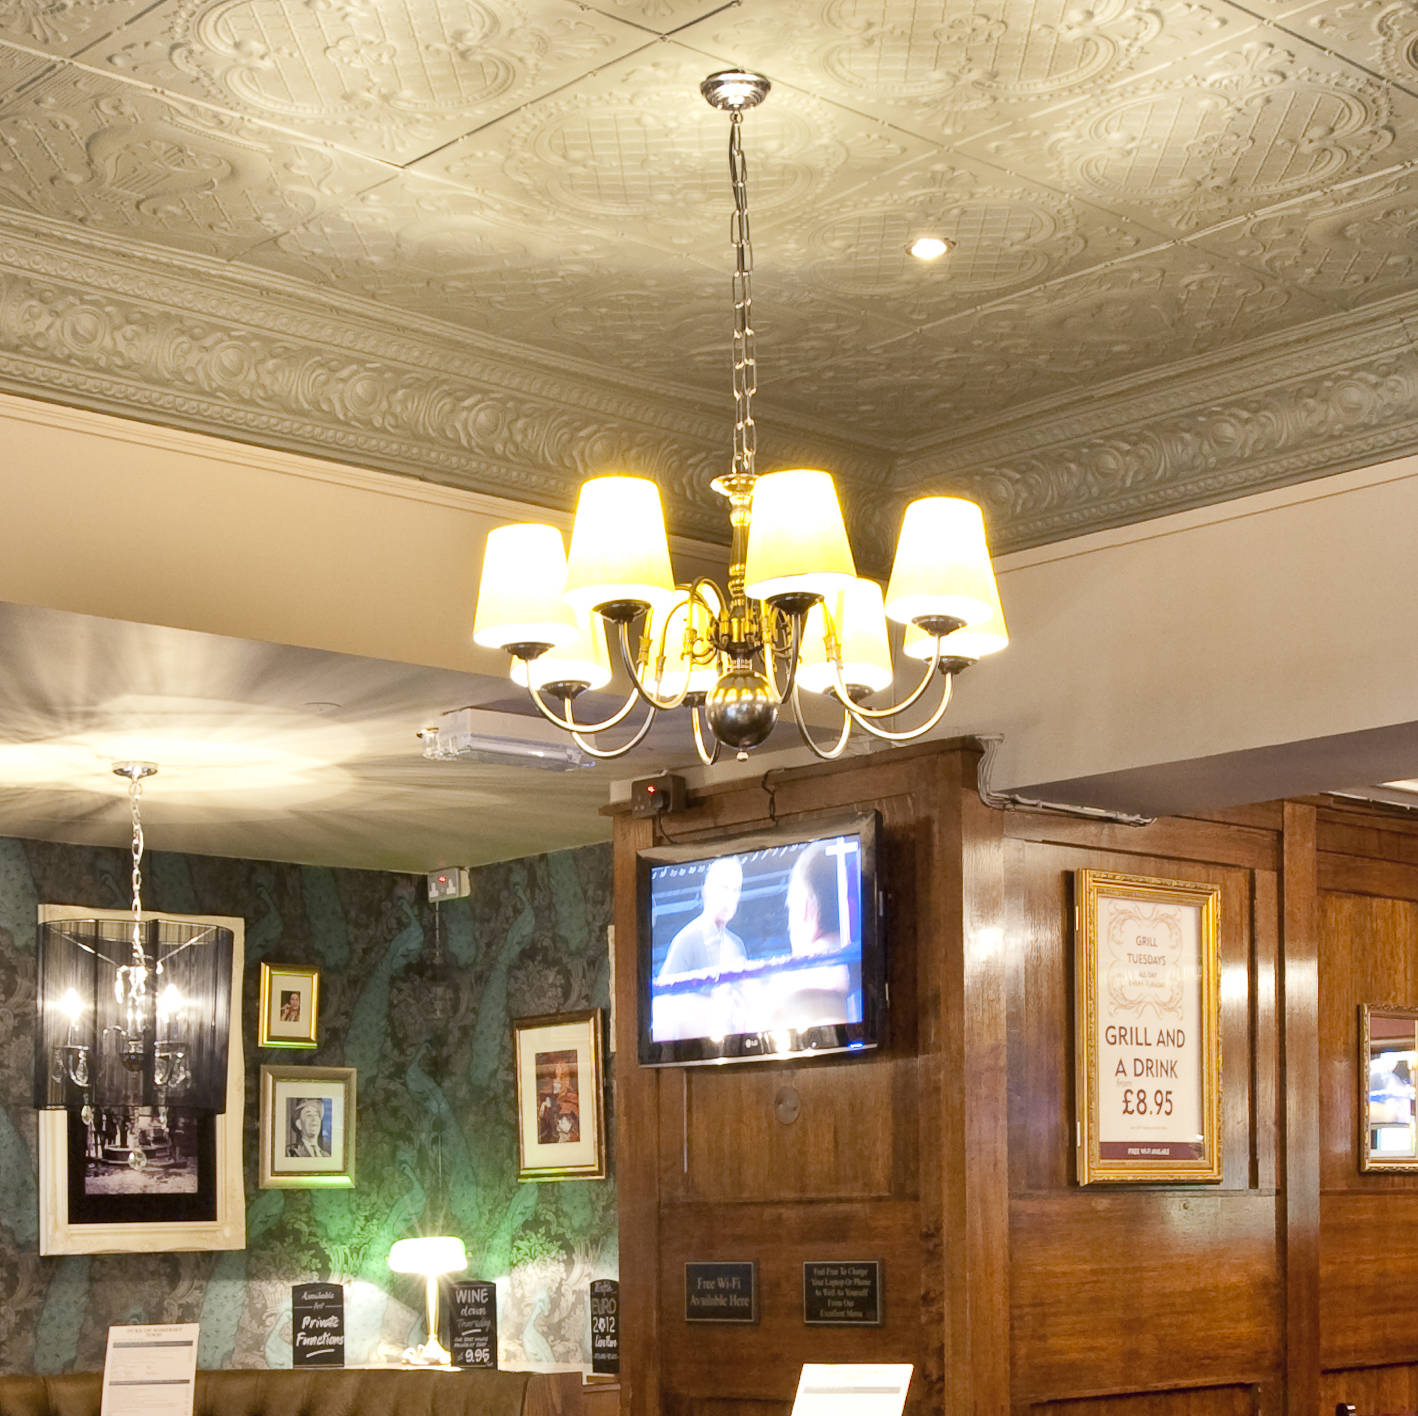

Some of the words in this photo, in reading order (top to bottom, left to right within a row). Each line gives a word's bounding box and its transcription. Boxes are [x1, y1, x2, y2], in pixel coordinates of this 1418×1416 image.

[1135, 935, 1158, 948] GRILL
[1126, 953, 1167, 966] TUESDAYS
[1104, 1025, 1152, 1046] GRILL
[1156, 1028, 1186, 1048] AND
[1114, 1058, 1128, 1077] A
[1133, 1057, 1179, 1079] DRINK
[1122, 1088, 1173, 1116] £8.95
[697, 1277, 716, 1290] Free
[717, 1276, 741, 1290] Wi-Fi
[455, 1288, 489, 1304] WINE
[689, 1294, 729, 1307] Available
[729, 1294, 750, 1307] Here
[460, 1305, 487, 1317] down
[591, 1297, 617, 1315] EURO
[301, 1315, 340, 1329] Private
[296, 1331, 345, 1347] Functions
[465, 1348, 490, 1363] 9.95
